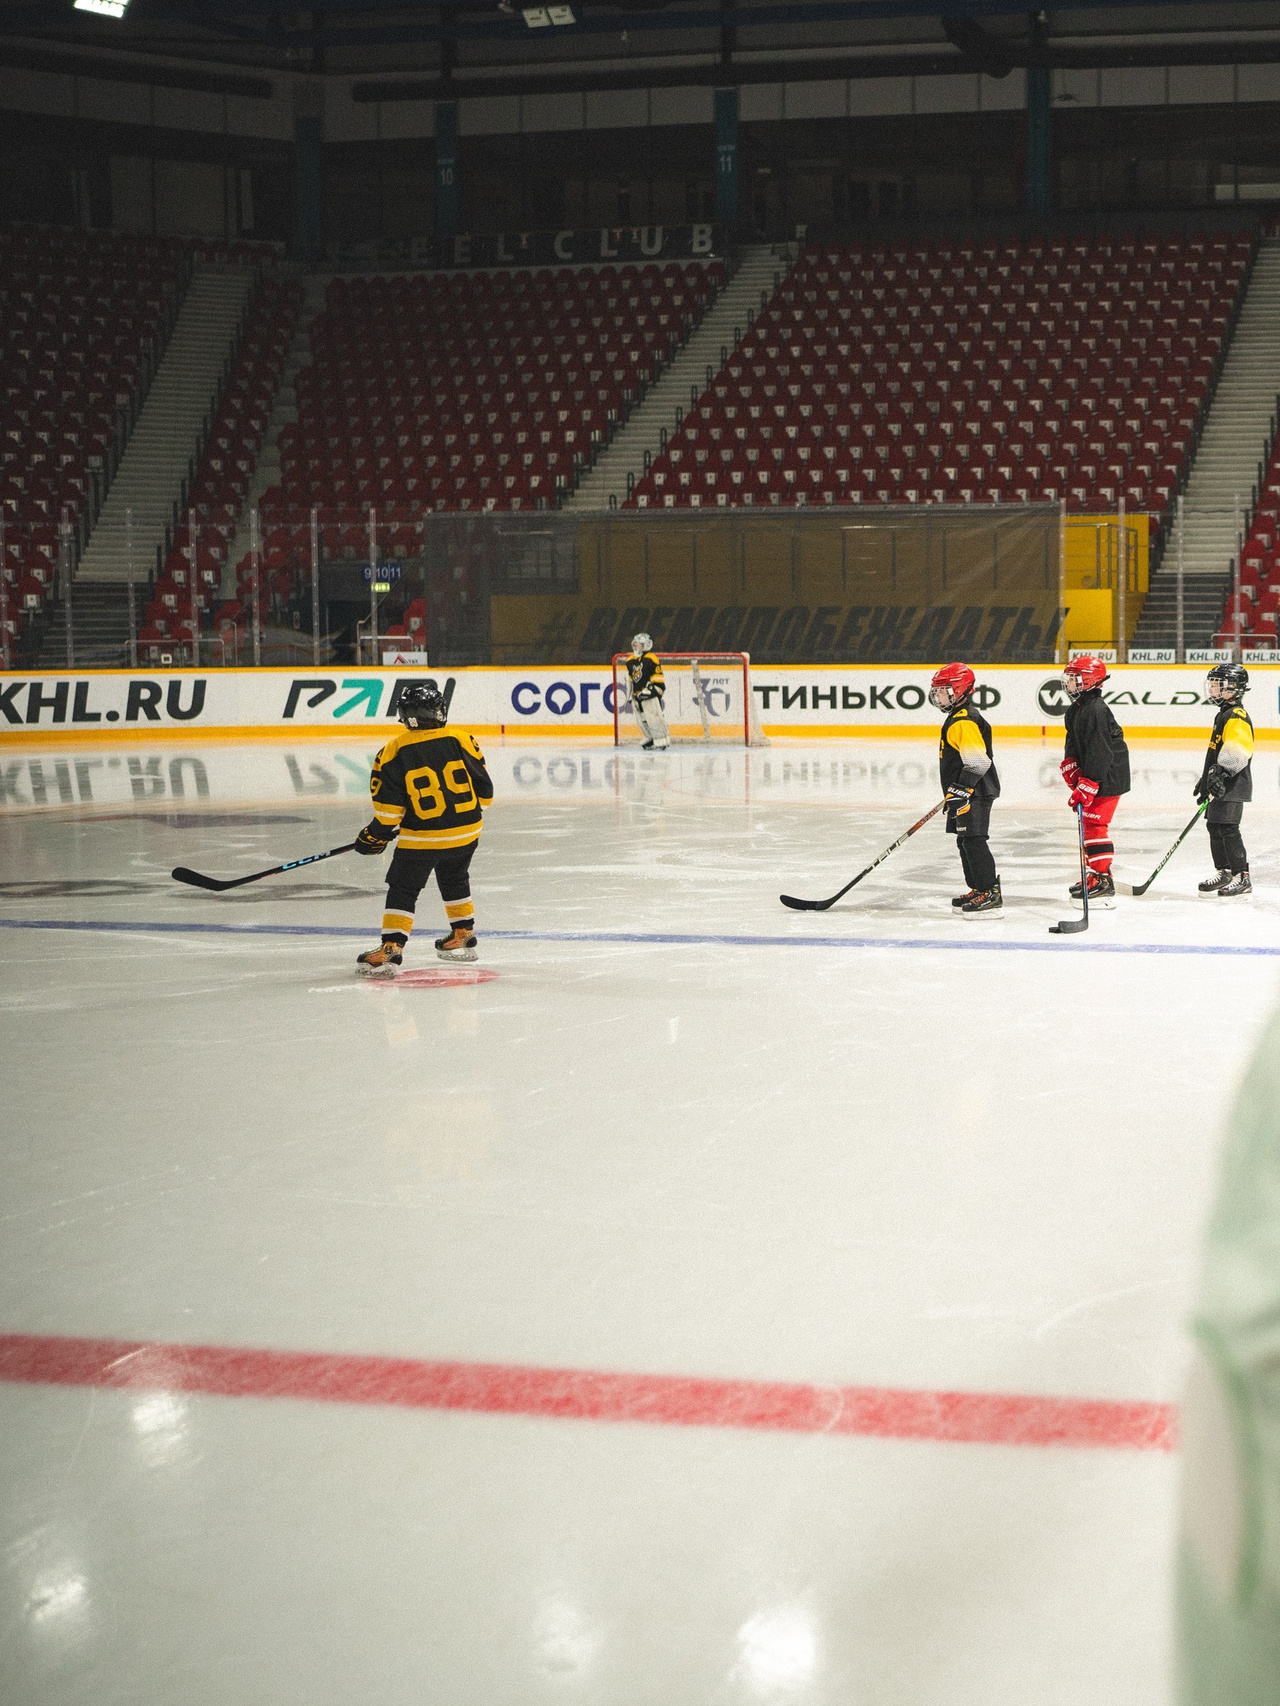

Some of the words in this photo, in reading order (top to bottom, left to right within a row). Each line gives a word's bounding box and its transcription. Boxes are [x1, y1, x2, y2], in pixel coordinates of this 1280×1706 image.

[719, 155, 733, 173] 11
[440, 167, 454, 186] 10
[554, 224, 714, 260] CLUB
[364, 566, 372, 580] 9
[390, 566, 402, 579] 11
[1131, 652, 1172, 662] KHL.RU
[1189, 652, 1229, 662] KHL.RU
[0, 680, 207, 725] KHL.RU
[754, 684, 1002, 711] ТИНЬКОФ
[404, 759, 479, 821] 89
